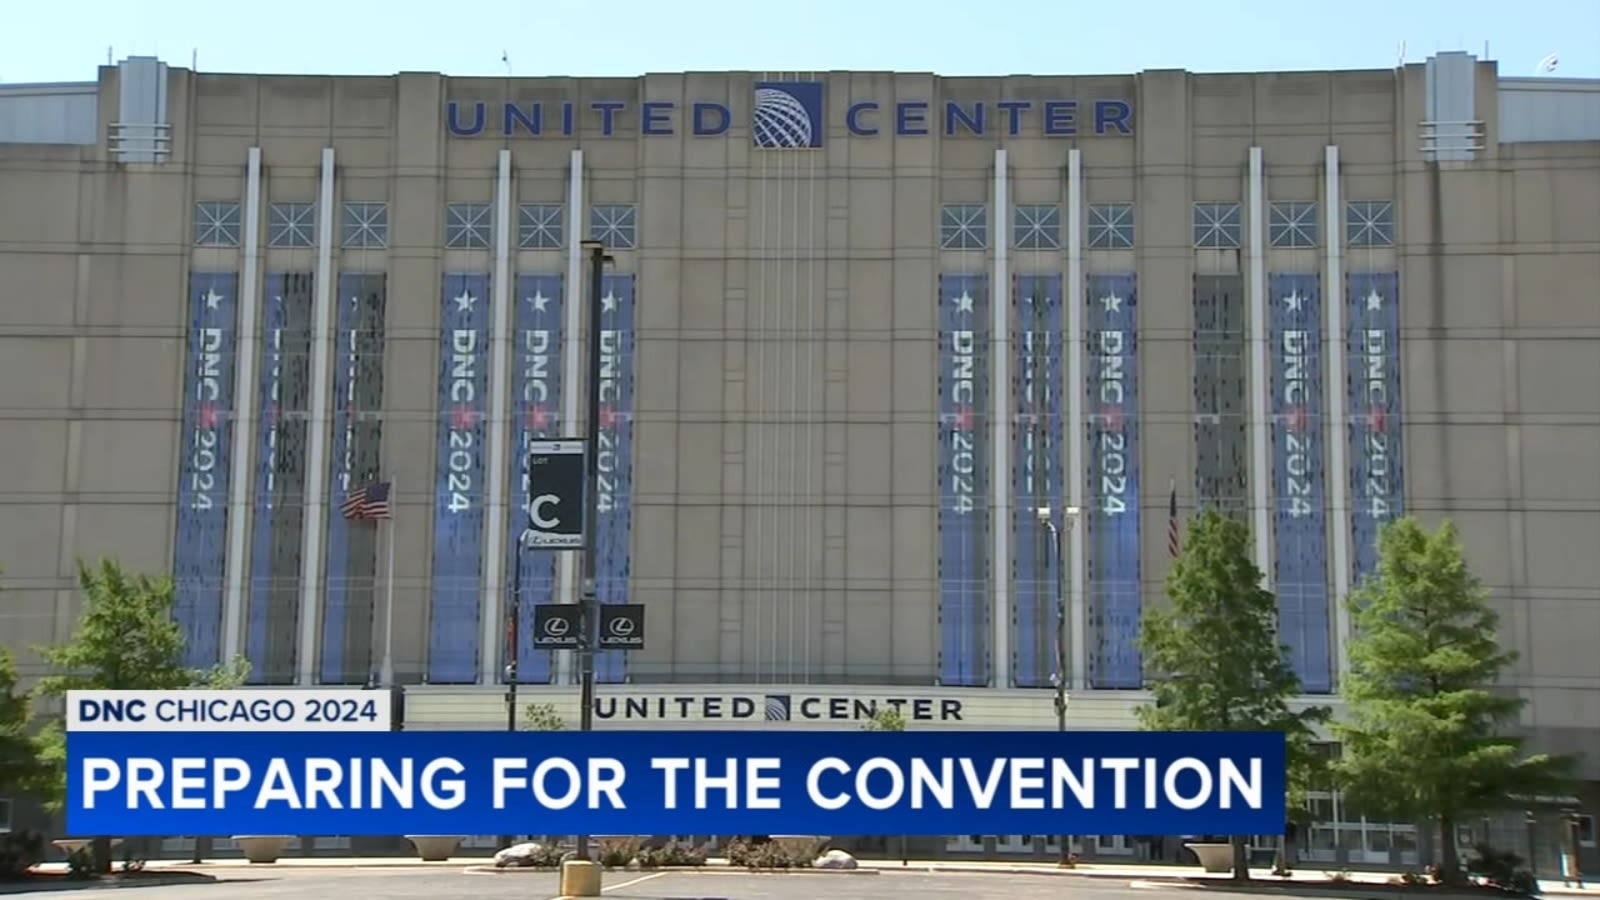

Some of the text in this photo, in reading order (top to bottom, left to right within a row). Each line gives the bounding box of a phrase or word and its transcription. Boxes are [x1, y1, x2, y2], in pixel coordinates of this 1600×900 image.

[447, 100, 1132, 135] UNITED CENTER
[191, 328, 222, 511] DNC 2024
[447, 329, 476, 514] DNC 2024
[523, 329, 549, 402] DNC
[595, 329, 621, 514] DNC 2024
[952, 330, 974, 515] DNC 2024
[1100, 330, 1126, 517] DNC 2024
[1283, 329, 1311, 519] DNC 2024
[1362, 329, 1390, 519] DNC 2024
[529, 494, 561, 529] C
[534, 636, 577, 644] LEXUS
[595, 697, 963, 720] UNITED CENTER
[600, 636, 642, 644] LEXUS
